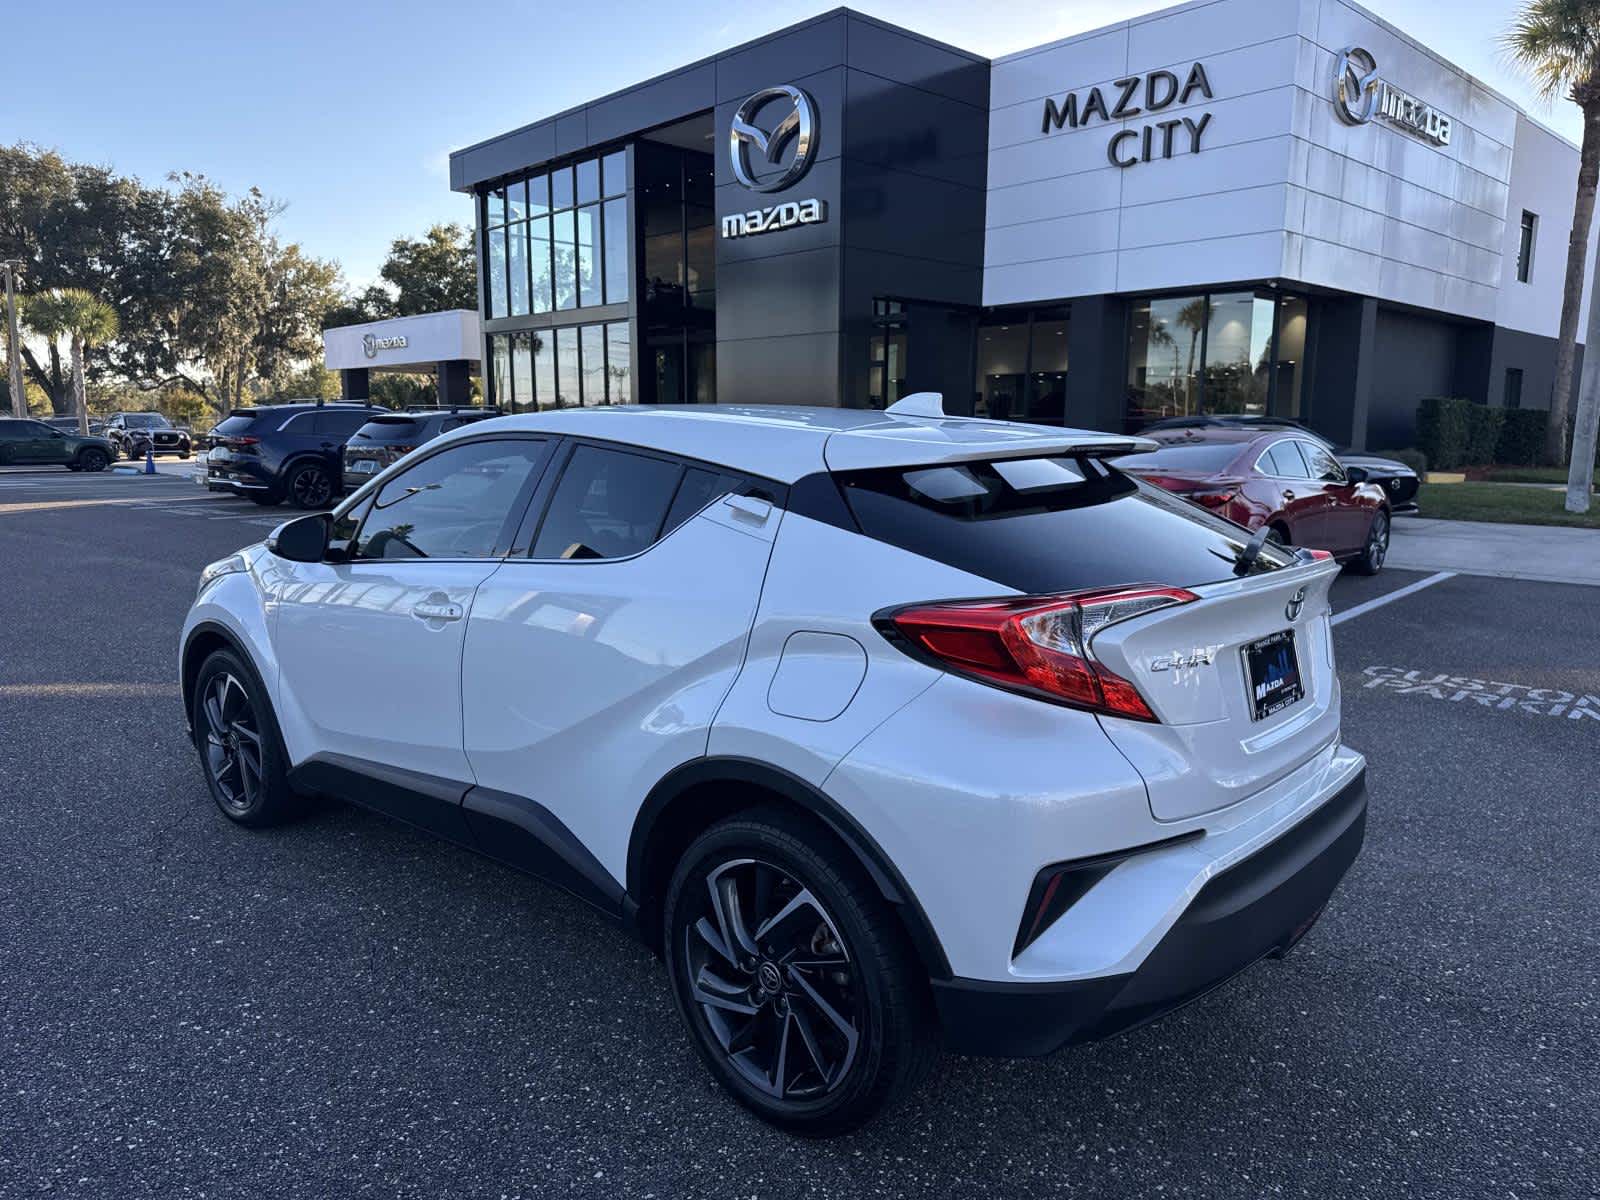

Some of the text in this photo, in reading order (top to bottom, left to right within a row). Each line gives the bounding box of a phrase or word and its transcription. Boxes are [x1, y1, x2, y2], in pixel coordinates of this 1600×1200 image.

[1041, 61, 1213, 134] MAZDA
[1379, 82, 1452, 145] mazda
[1107, 112, 1212, 168] CITY
[722, 198, 827, 239] mazda
[375, 335, 408, 350] mazda
[1268, 702, 1285, 713] MAZDA
